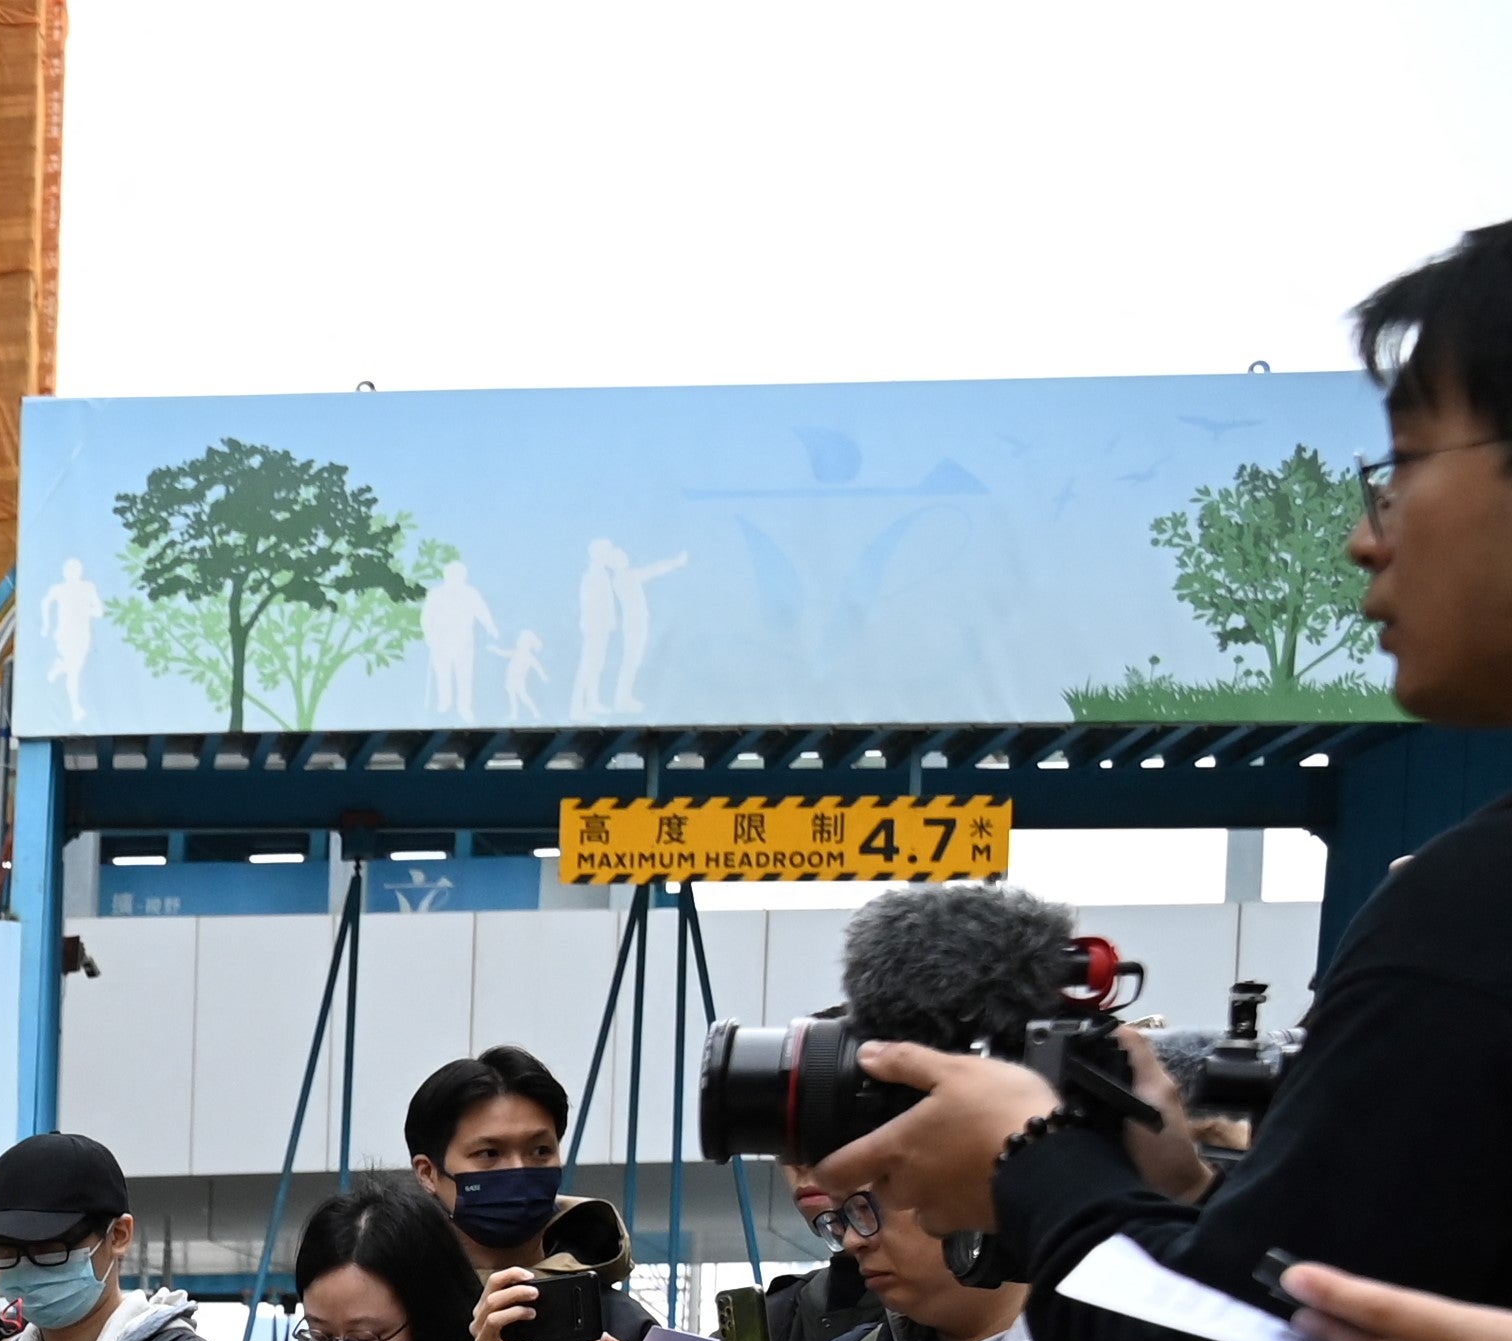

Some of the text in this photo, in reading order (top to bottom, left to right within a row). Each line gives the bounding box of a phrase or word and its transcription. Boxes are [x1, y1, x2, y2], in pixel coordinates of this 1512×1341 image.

[577, 842, 991, 869] MAXIMUM HEADROOM M
[578, 812, 993, 864] 高度限制 4.7 米
